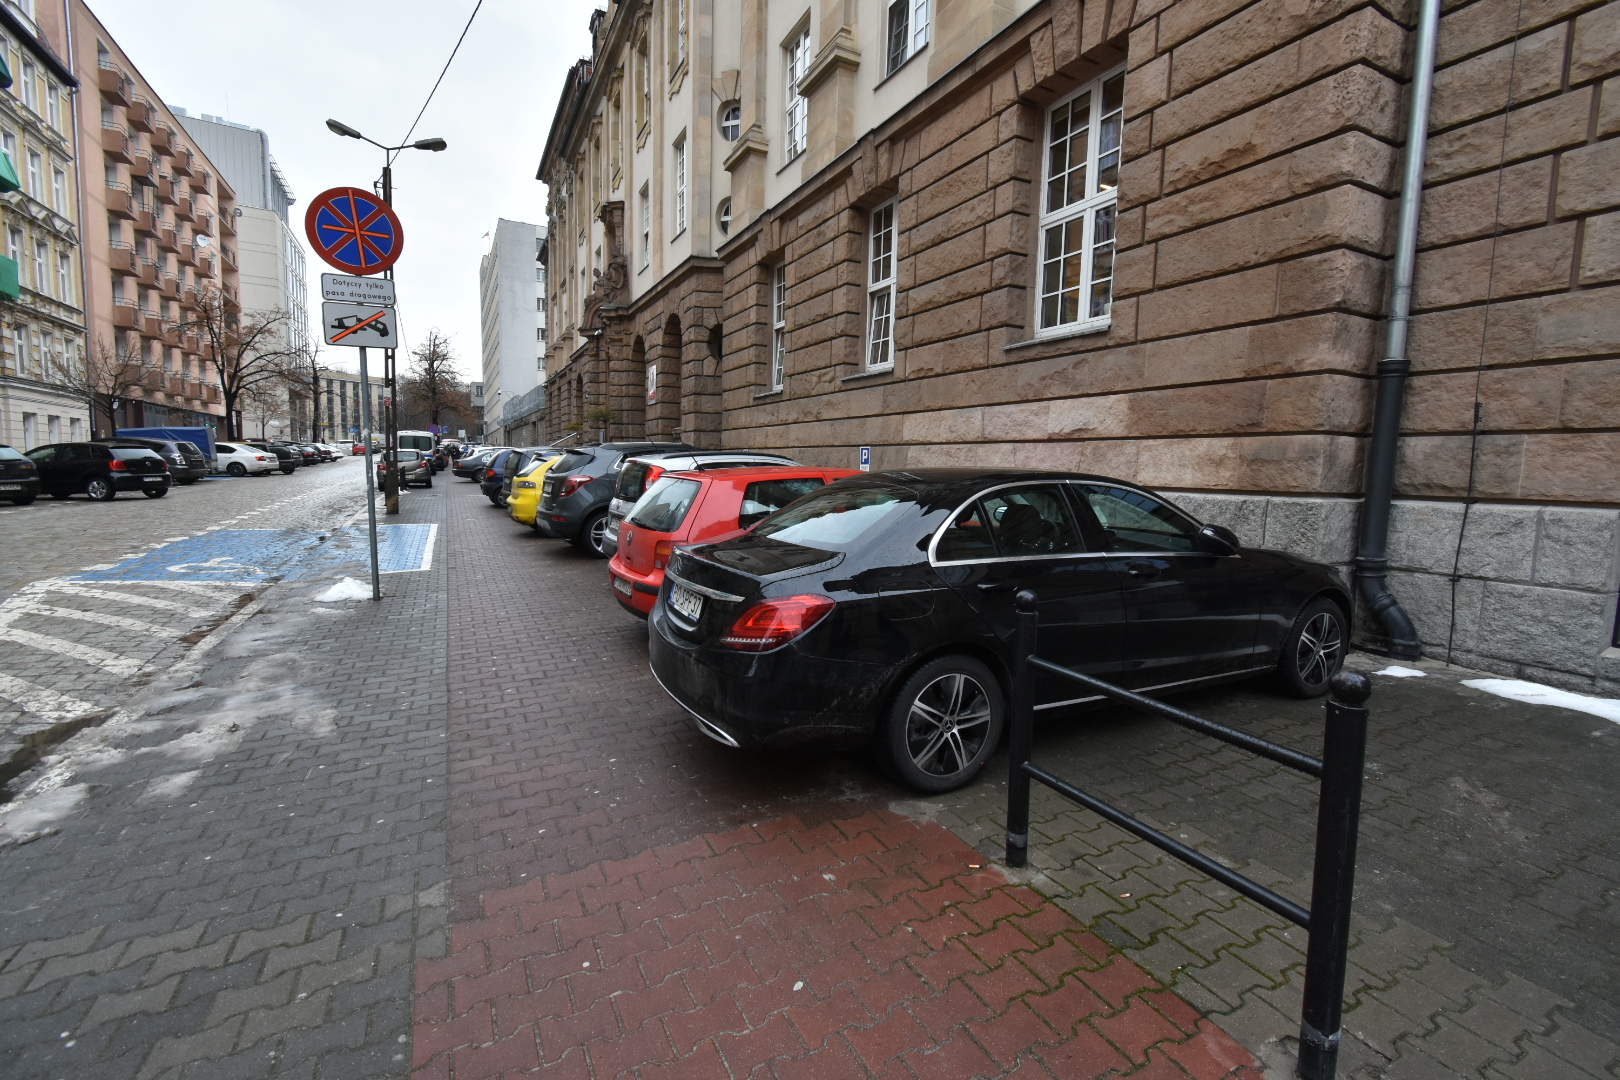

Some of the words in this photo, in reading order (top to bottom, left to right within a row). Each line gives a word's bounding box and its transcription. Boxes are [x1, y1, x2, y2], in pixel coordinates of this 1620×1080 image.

[332, 279, 361, 288] Dotyczy
[349, 291, 391, 301] drogowego
[862, 450, 868, 462] P
